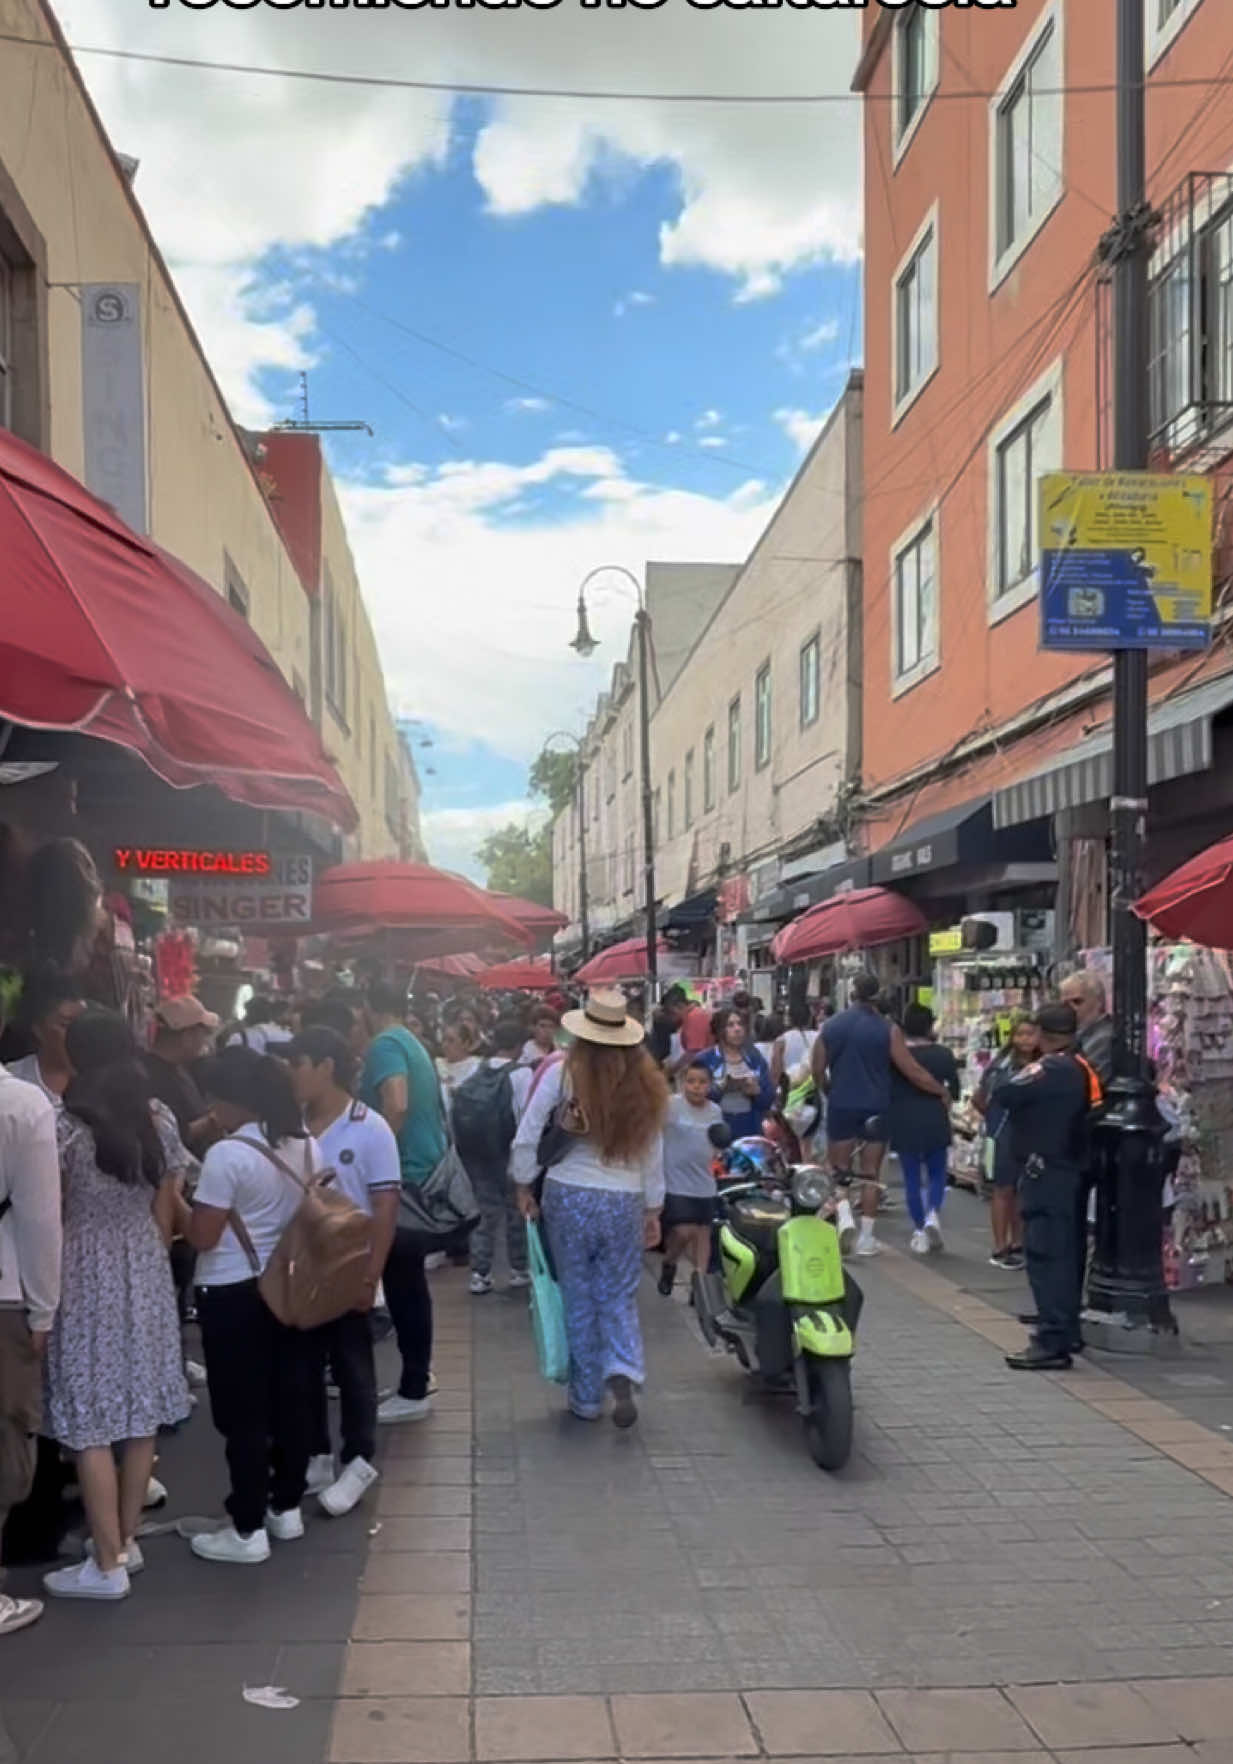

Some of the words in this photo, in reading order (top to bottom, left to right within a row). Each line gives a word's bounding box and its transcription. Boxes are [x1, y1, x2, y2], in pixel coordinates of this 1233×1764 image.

[116, 850, 130, 867] Y
[136, 850, 269, 873] VERTICALES
[172, 894, 307, 921] SINGER
